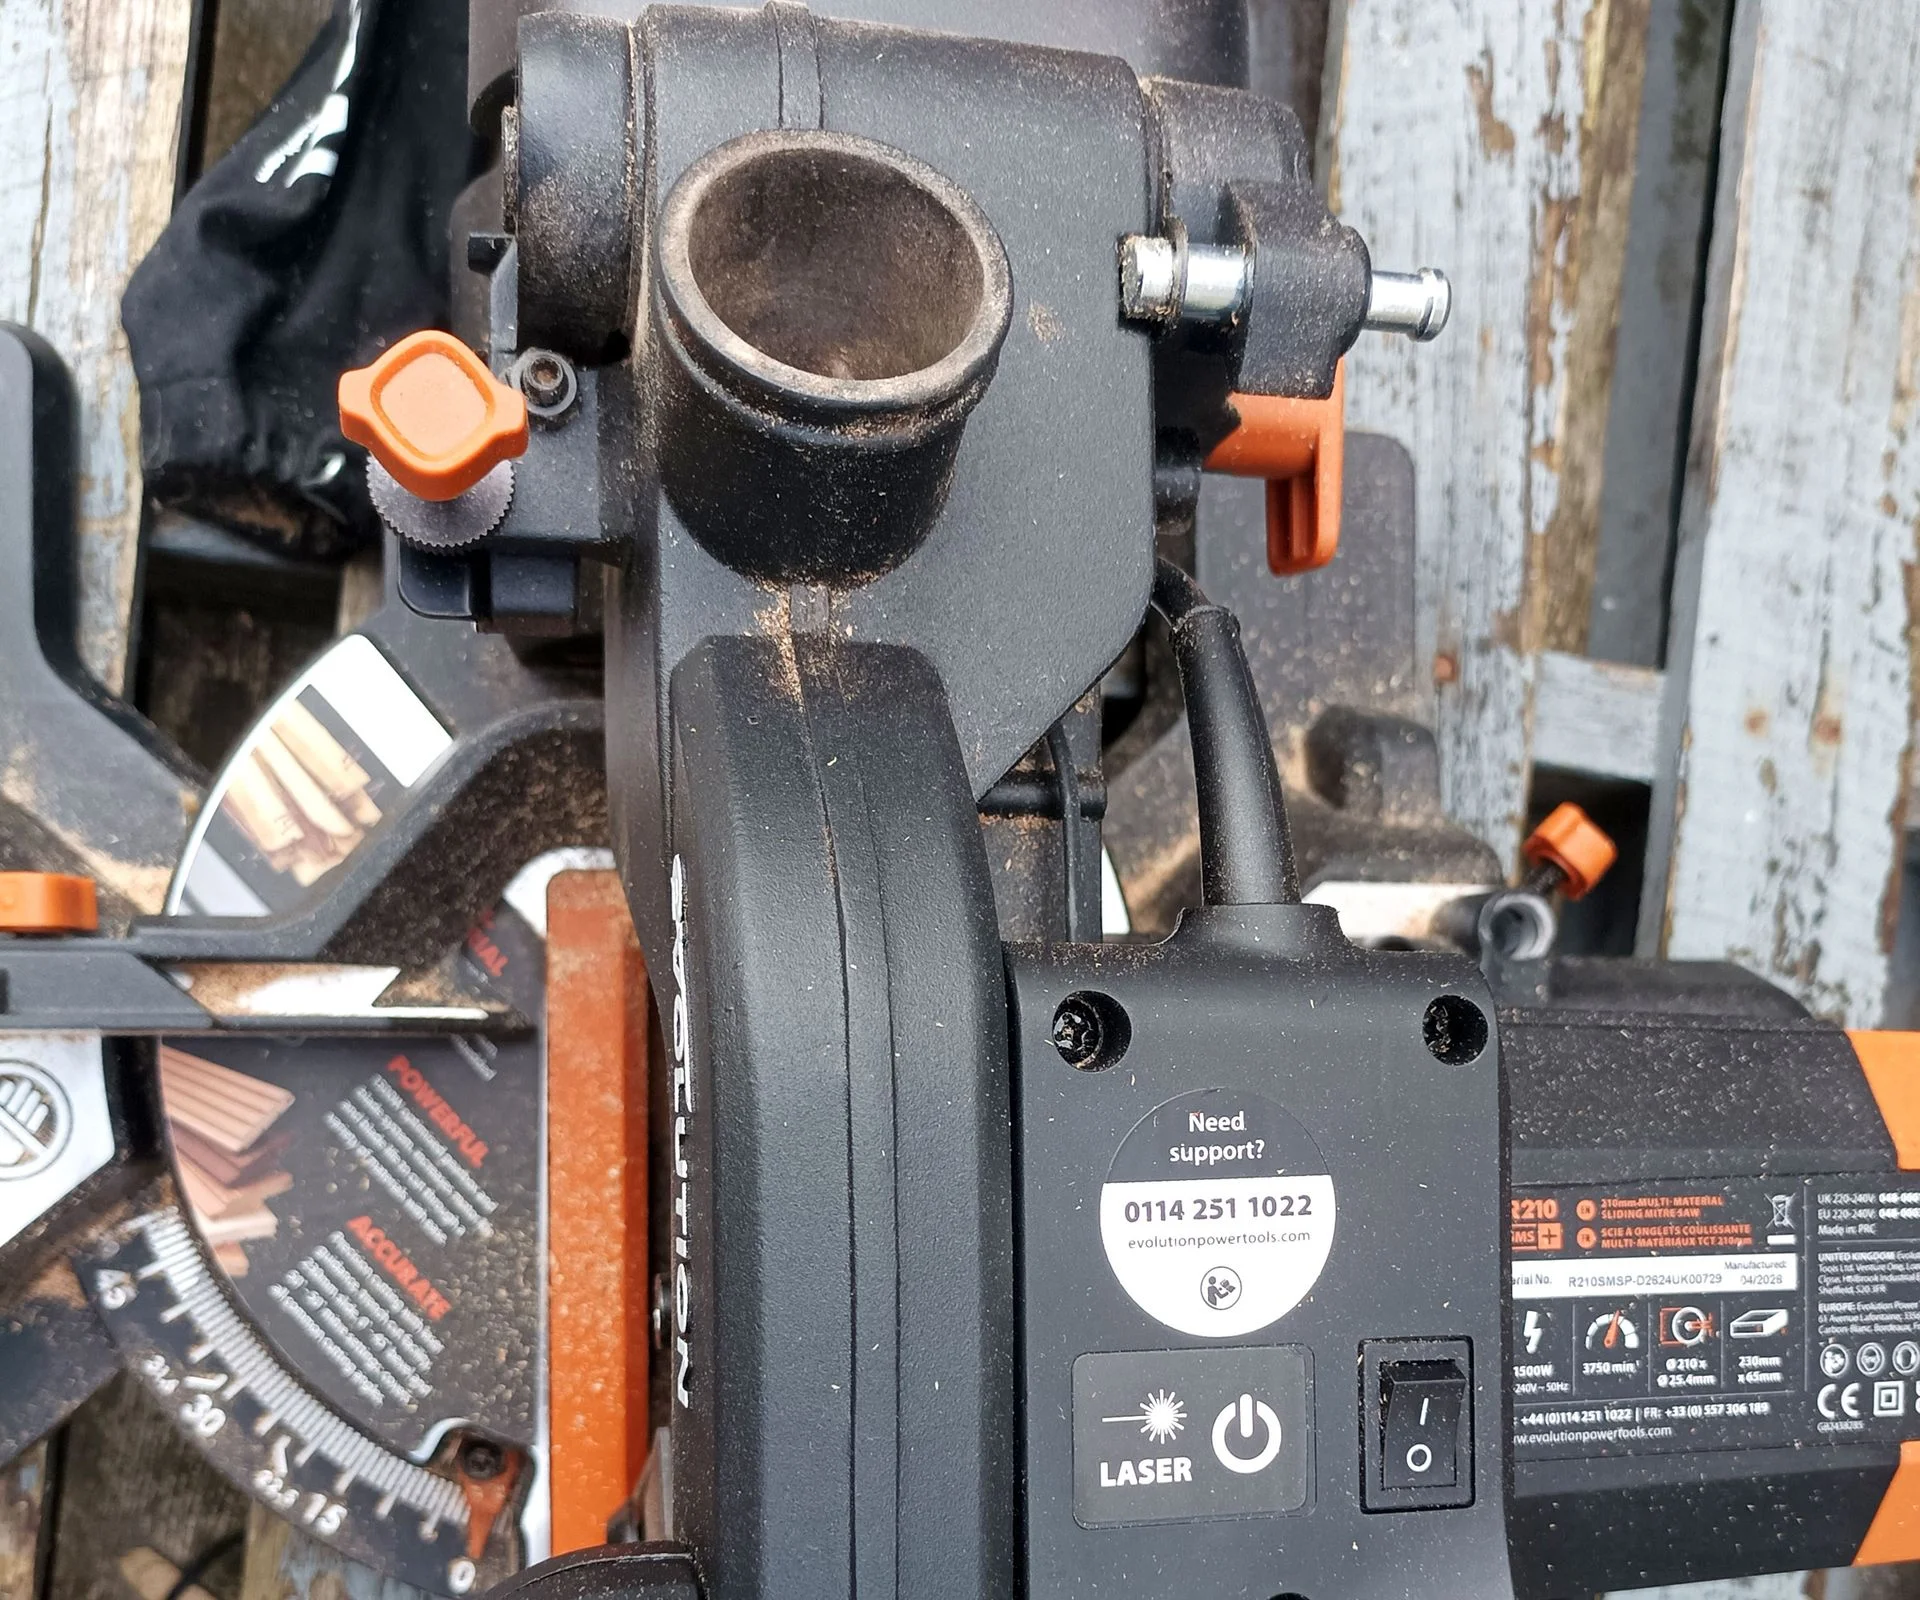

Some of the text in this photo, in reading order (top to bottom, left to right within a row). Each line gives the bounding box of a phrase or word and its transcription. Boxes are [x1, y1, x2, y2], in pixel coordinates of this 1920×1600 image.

[385, 1054, 489, 1168] POWERFUL
[1189, 1111, 1245, 1132] Need
[1169, 1140, 1265, 1166] support?
[1124, 1195, 1312, 1222] 0114 251 1022
[1601, 1207, 1702, 1219] SLIDING MITRE SAW
[1601, 1227, 1624, 1237] SCIE
[1634, 1225, 1681, 1236] ONGLETS
[1682, 1223, 1751, 1235] COULISSANTE
[1817, 1225, 1844, 1236] Made
[1128, 1231, 1311, 1249] evolutionpowertools.com
[1697, 1236, 1716, 1246] TCT
[1724, 1260, 1787, 1270] Manufactured:
[1817, 1252, 1851, 1262] UNITED
[346, 1215, 451, 1323] ACCURATE
[1535, 1274, 1553, 1285] No.
[1582, 1362, 1611, 1375] 3750
[1738, 1355, 1782, 1367] 230mm
[1546, 1381, 1569, 1392] 50Hz
[179, 1394, 227, 1437] 30
[1604, 1408, 1632, 1421] 1022
[1643, 1406, 1661, 1419] FR:
[1703, 1403, 1724, 1416] 557
[1725, 1402, 1748, 1416] 306
[1748, 1402, 1771, 1415] 189
[1100, 1456, 1192, 1488] LASER
[302, 1493, 348, 1536] 15
